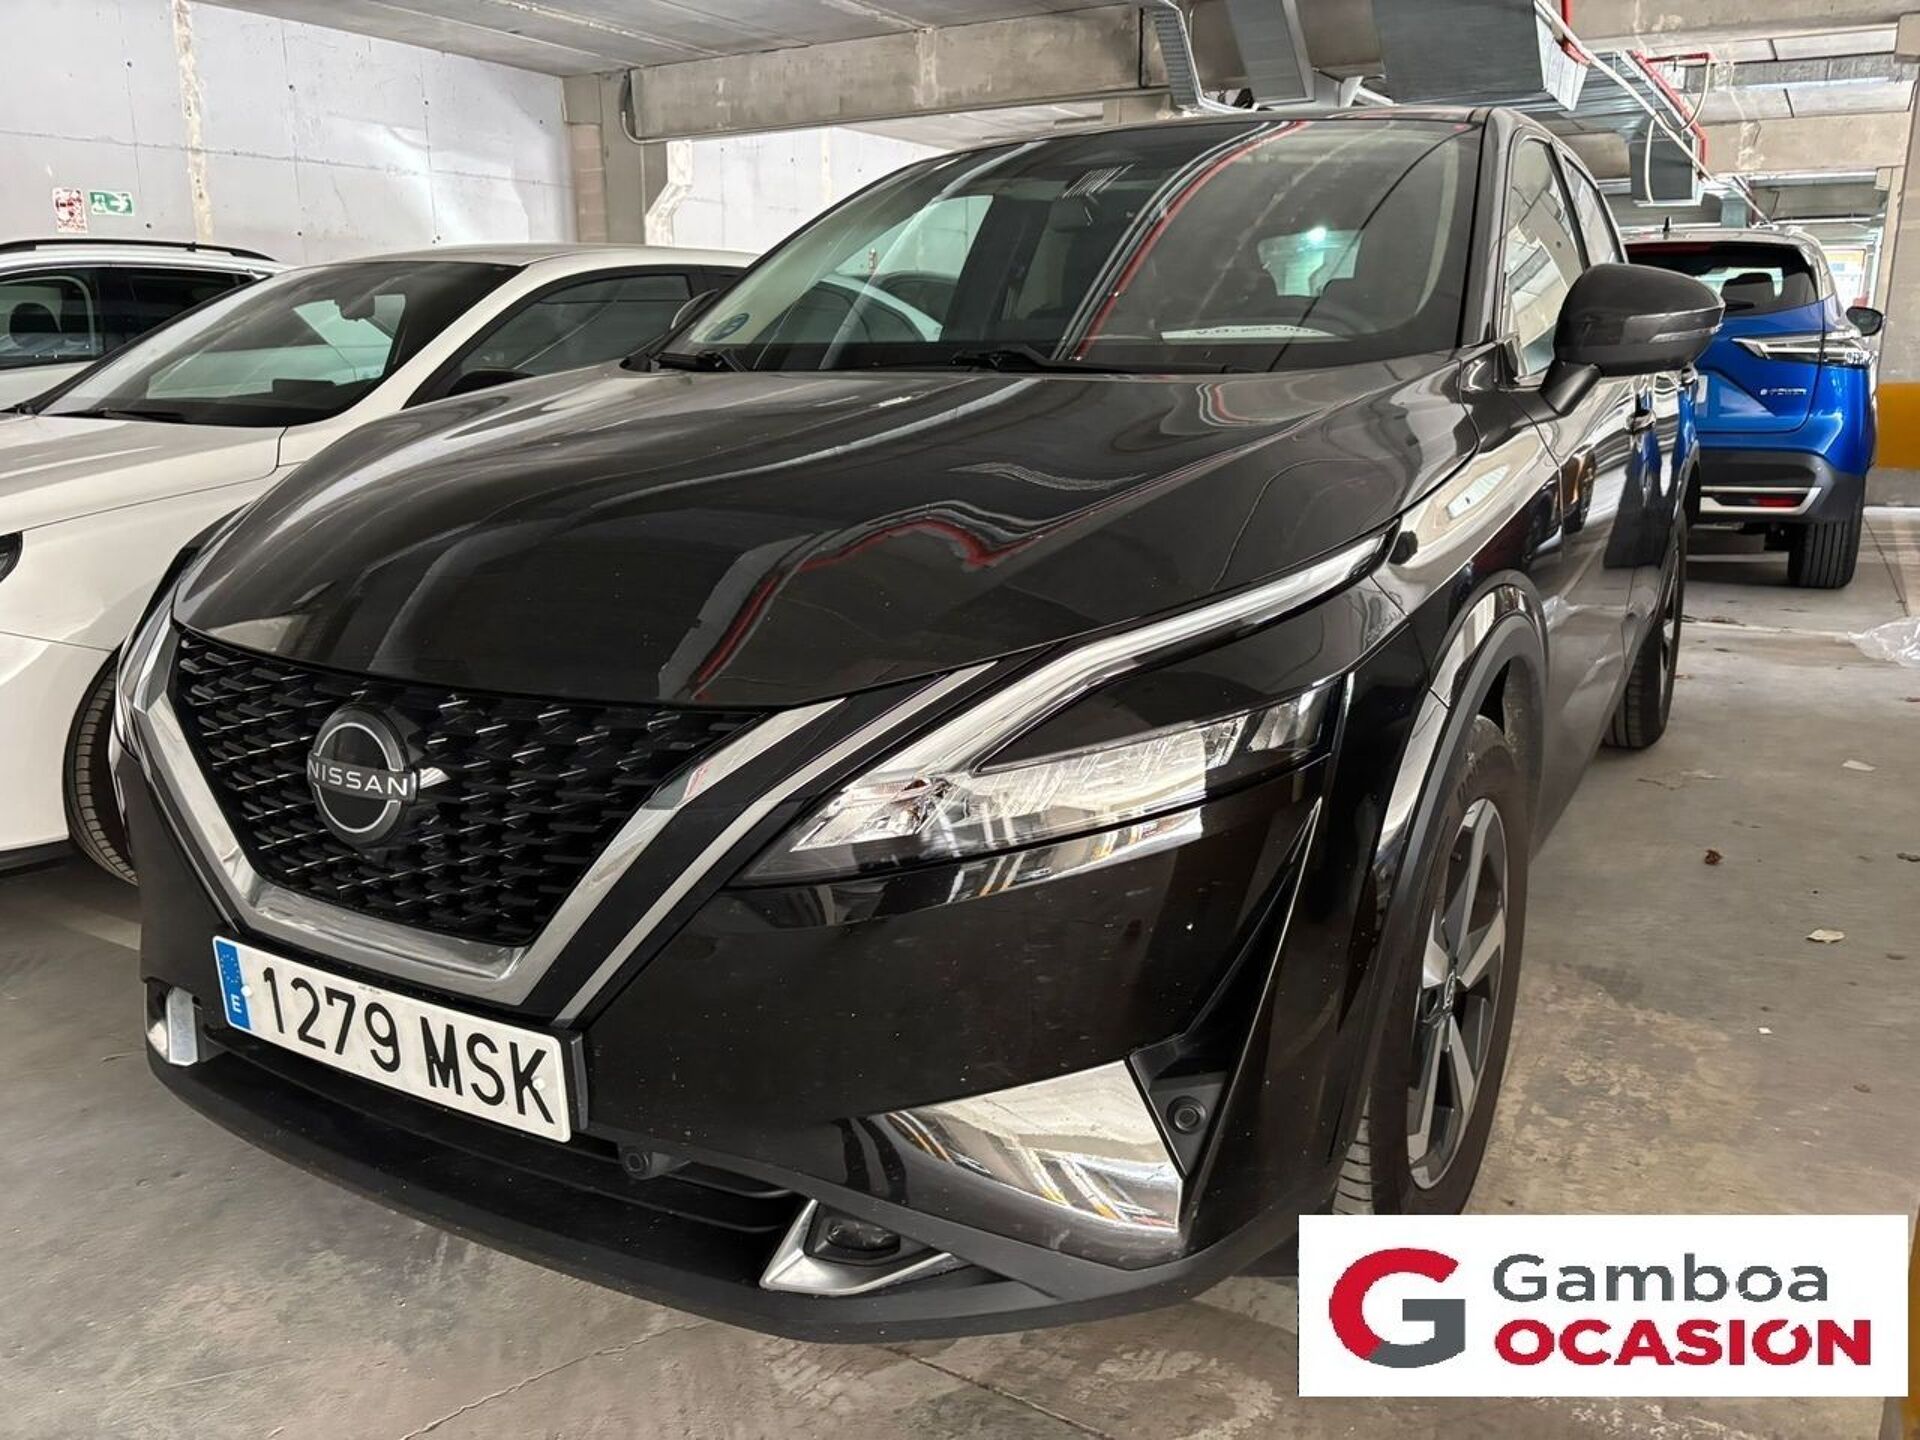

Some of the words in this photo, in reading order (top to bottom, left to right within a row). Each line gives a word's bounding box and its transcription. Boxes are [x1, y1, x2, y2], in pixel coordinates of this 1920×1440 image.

[307, 759, 408, 796] NISSAN
[230, 993, 242, 1014] E
[263, 967, 401, 1073] 1279
[420, 1016, 555, 1125] MSK
